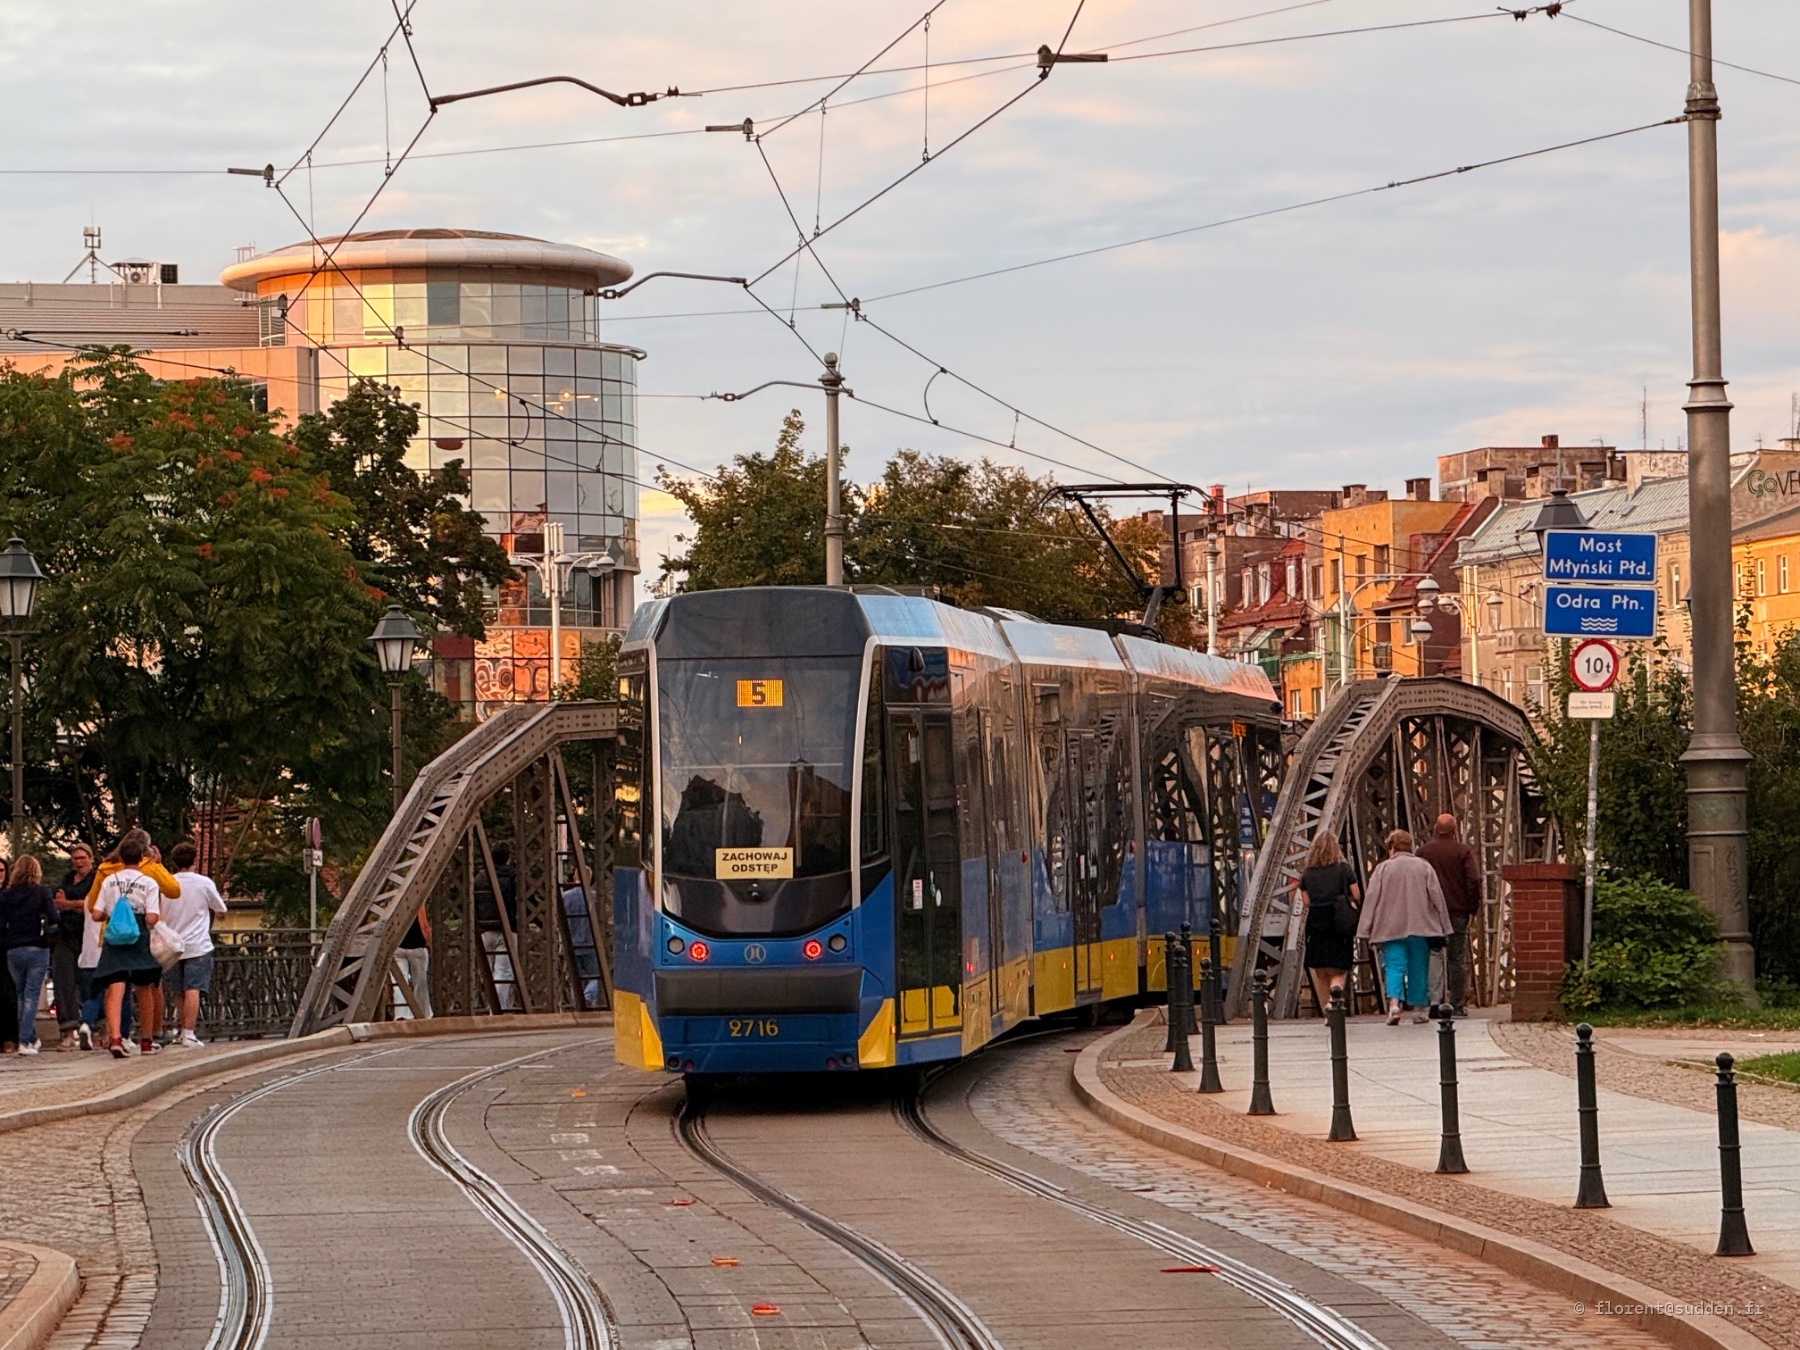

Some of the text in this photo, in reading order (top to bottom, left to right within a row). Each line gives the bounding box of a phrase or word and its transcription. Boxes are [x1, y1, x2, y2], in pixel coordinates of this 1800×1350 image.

[1579, 537, 1622, 553] Most
[1549, 558, 1651, 578] Młyński Płd.
[1556, 593, 1645, 610] Odra Płn.
[752, 682, 766, 705] 5
[721, 851, 788, 862] ZACHOWAJ
[731, 863, 778, 874] ODSTĘP
[728, 1019, 779, 1037] 2716
